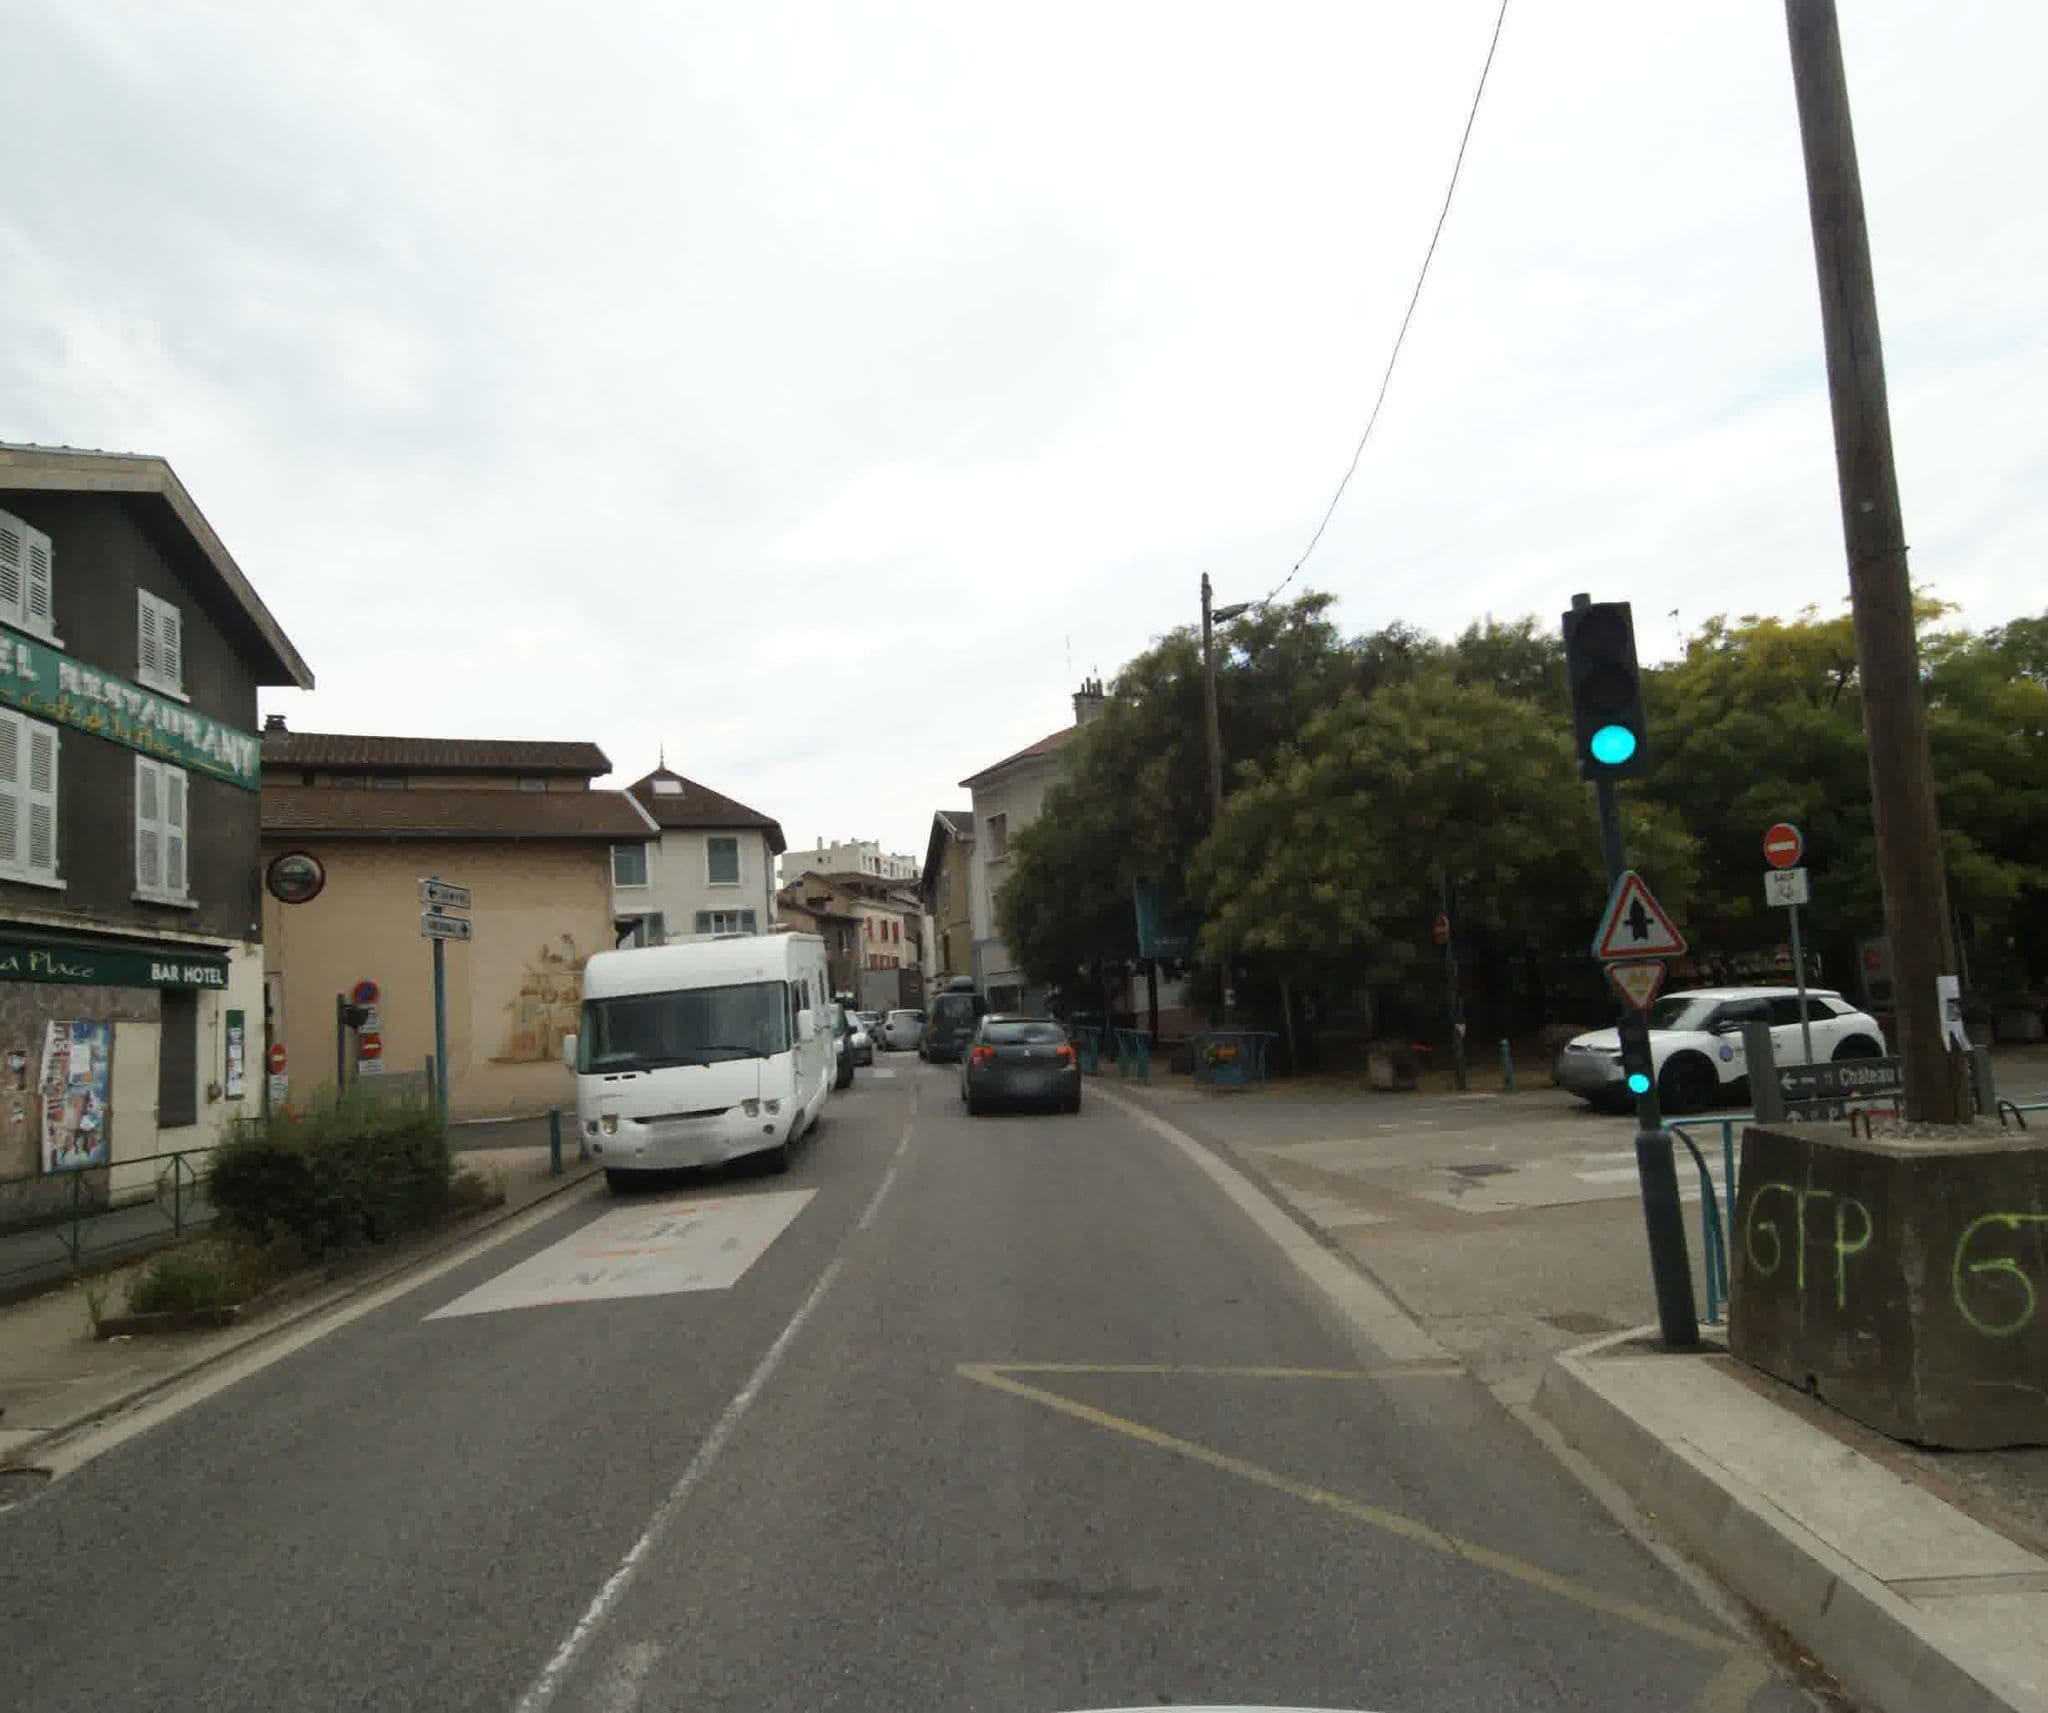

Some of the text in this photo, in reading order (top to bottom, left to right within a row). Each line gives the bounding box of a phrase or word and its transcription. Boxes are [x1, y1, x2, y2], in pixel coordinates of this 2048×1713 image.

[59, 661, 254, 777] RESTAURANT
[151, 962, 224, 985] BAR HOTEL
[1747, 1183, 1873, 1311] GTP
